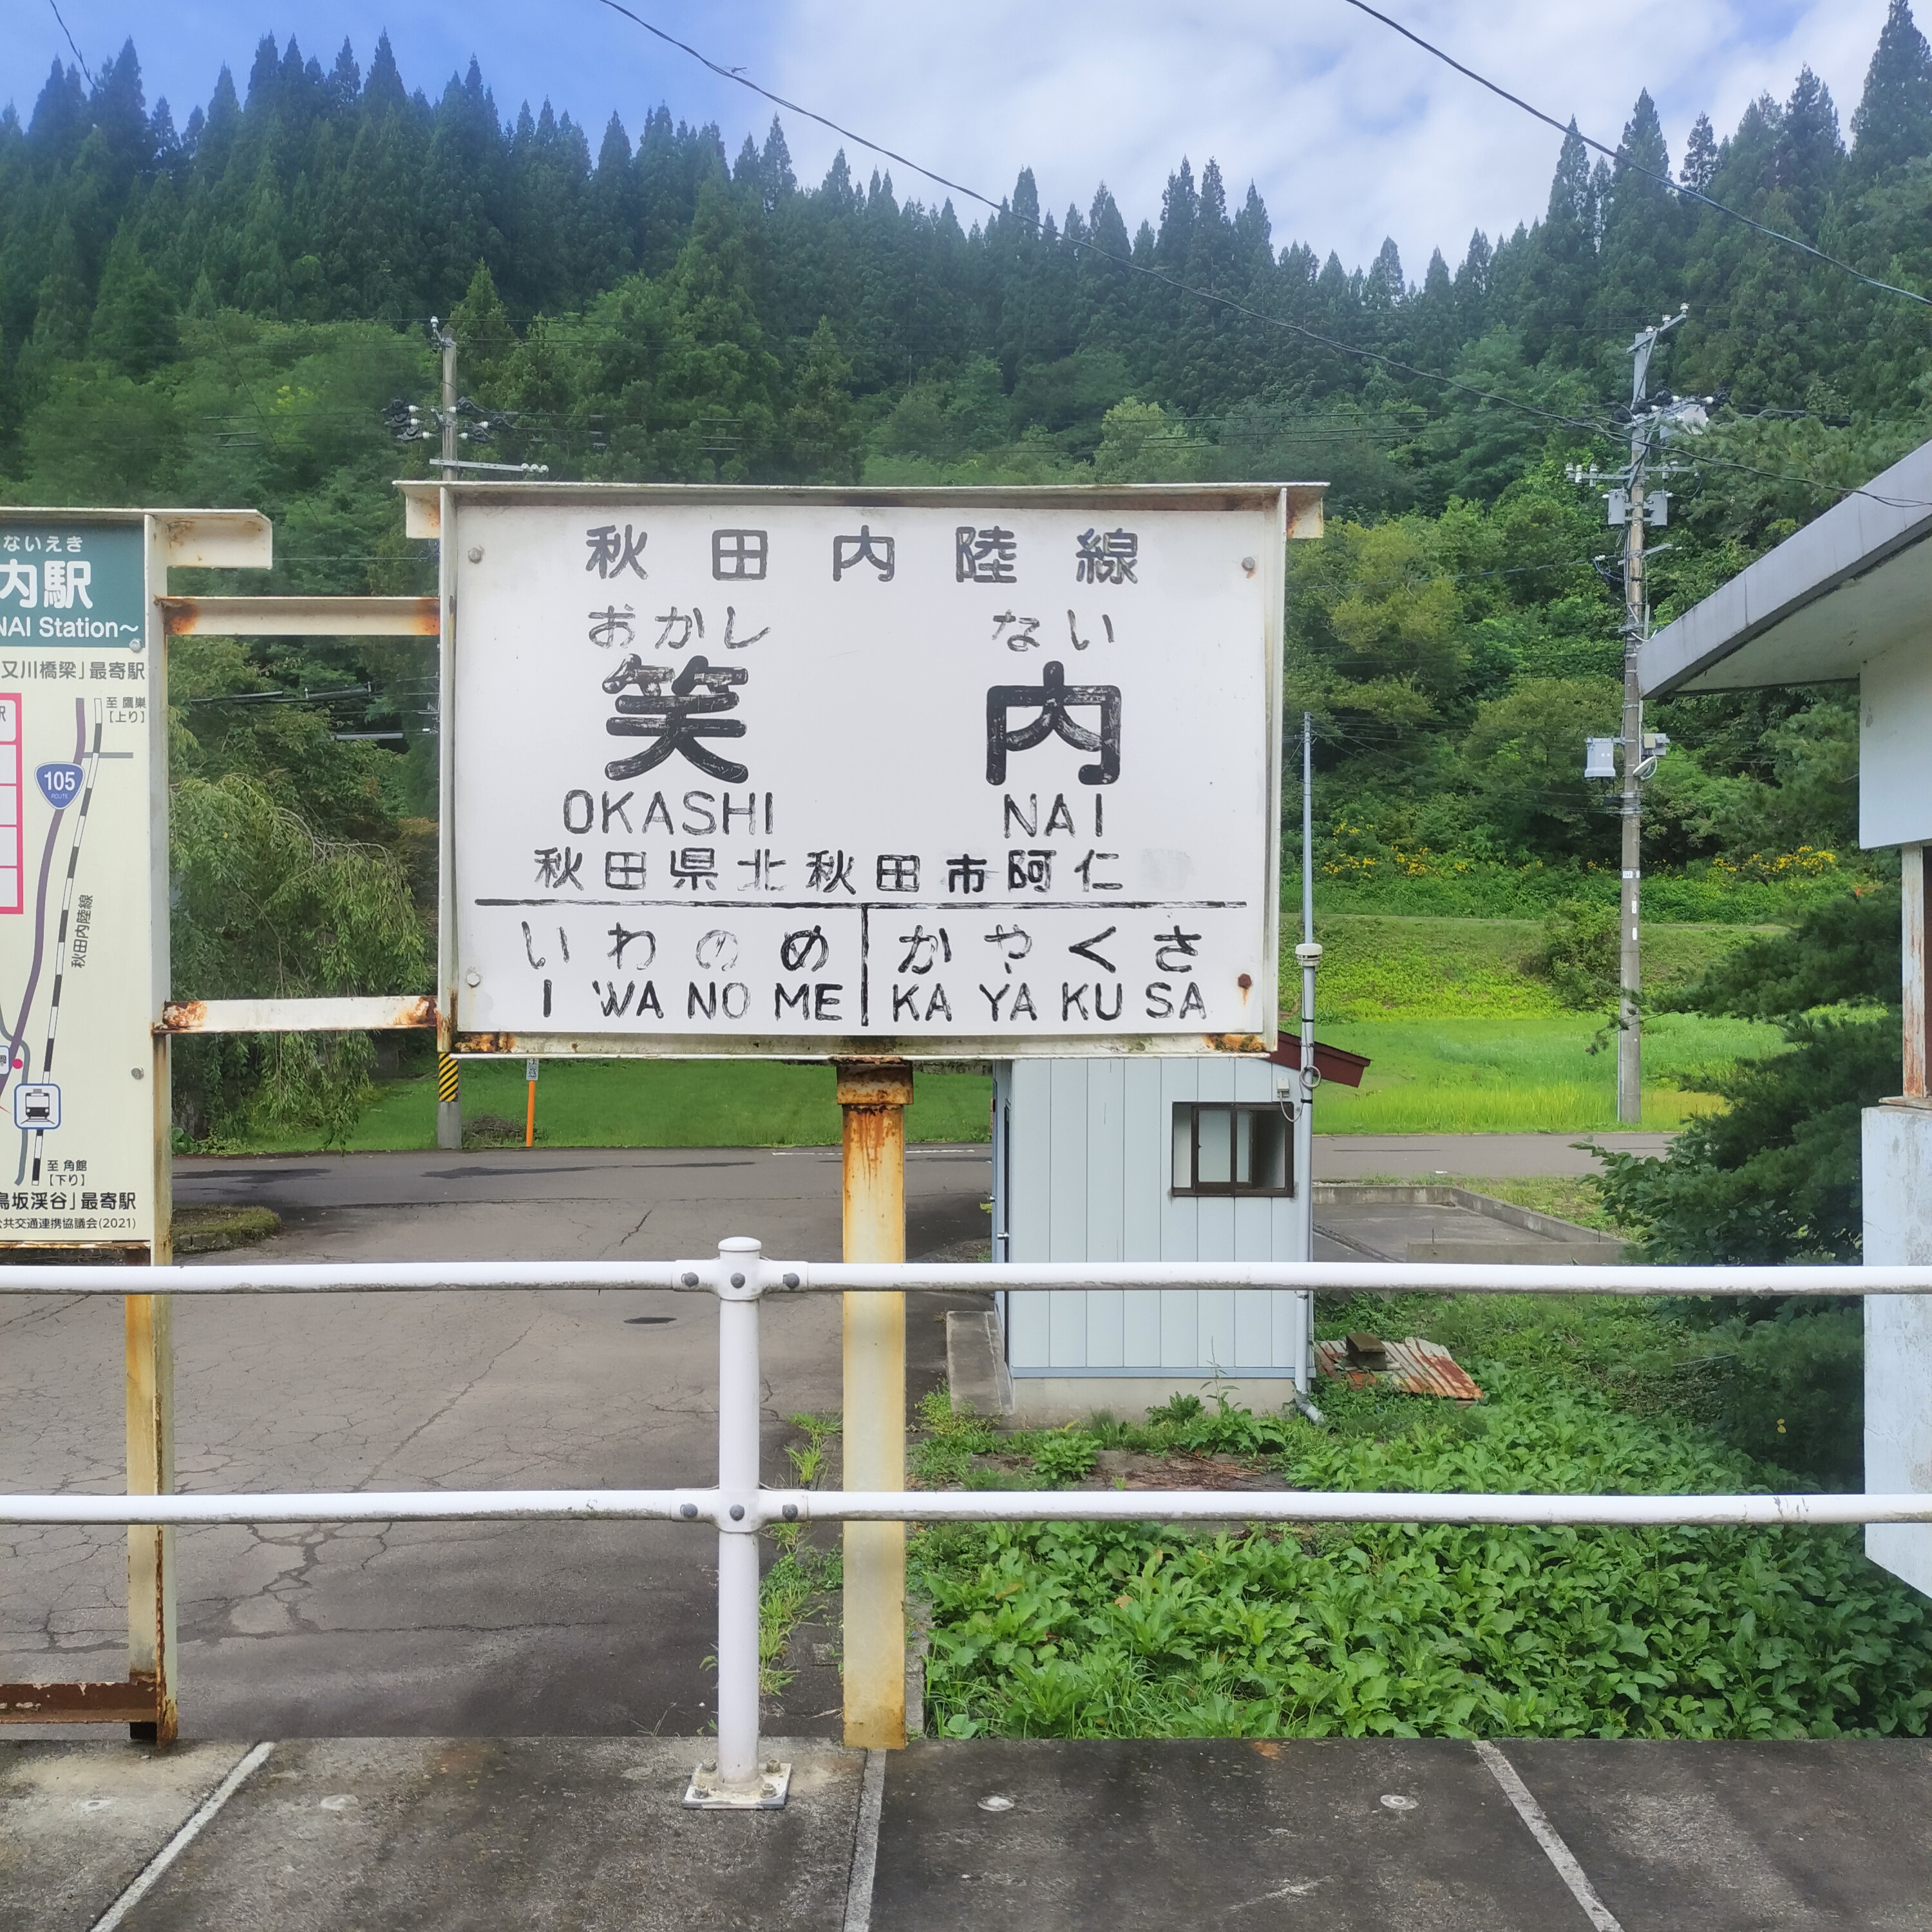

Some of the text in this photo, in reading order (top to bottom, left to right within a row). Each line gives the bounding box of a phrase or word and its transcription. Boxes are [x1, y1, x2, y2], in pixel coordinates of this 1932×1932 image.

[3, 535, 83, 553] ないえき
[585, 524, 1138, 584] 秋田内陸線
[0, 558, 93, 609] 内駅
[588, 604, 1114, 652] おかし ない
[1, 661, 145, 679] 又川橋梁」最寄駅
[106, 697, 117, 708] 至
[109, 711, 145, 723] 【上り】
[601, 653, 1122, 786] 笑 内
[44, 771, 75, 791] 105
[563, 789, 1103, 838] OKASHI NAI
[534, 846, 1123, 895] 秋田県北秋田市阿仁
[71, 895, 93, 969] 秋田内陸線
[522, 921, 829, 972] いわのめ
[898, 925, 1202, 974] かやくさ
[687, 981, 751, 1019] NO
[774, 983, 844, 1021] ME
[893, 982, 1207, 1023] KA YA KU SA
[47, 1160, 87, 1171] 至 角館
[50, 1174, 85, 1186] 【下り】
[0, 1217, 136, 1229] 共交通連携協議会(2021)
